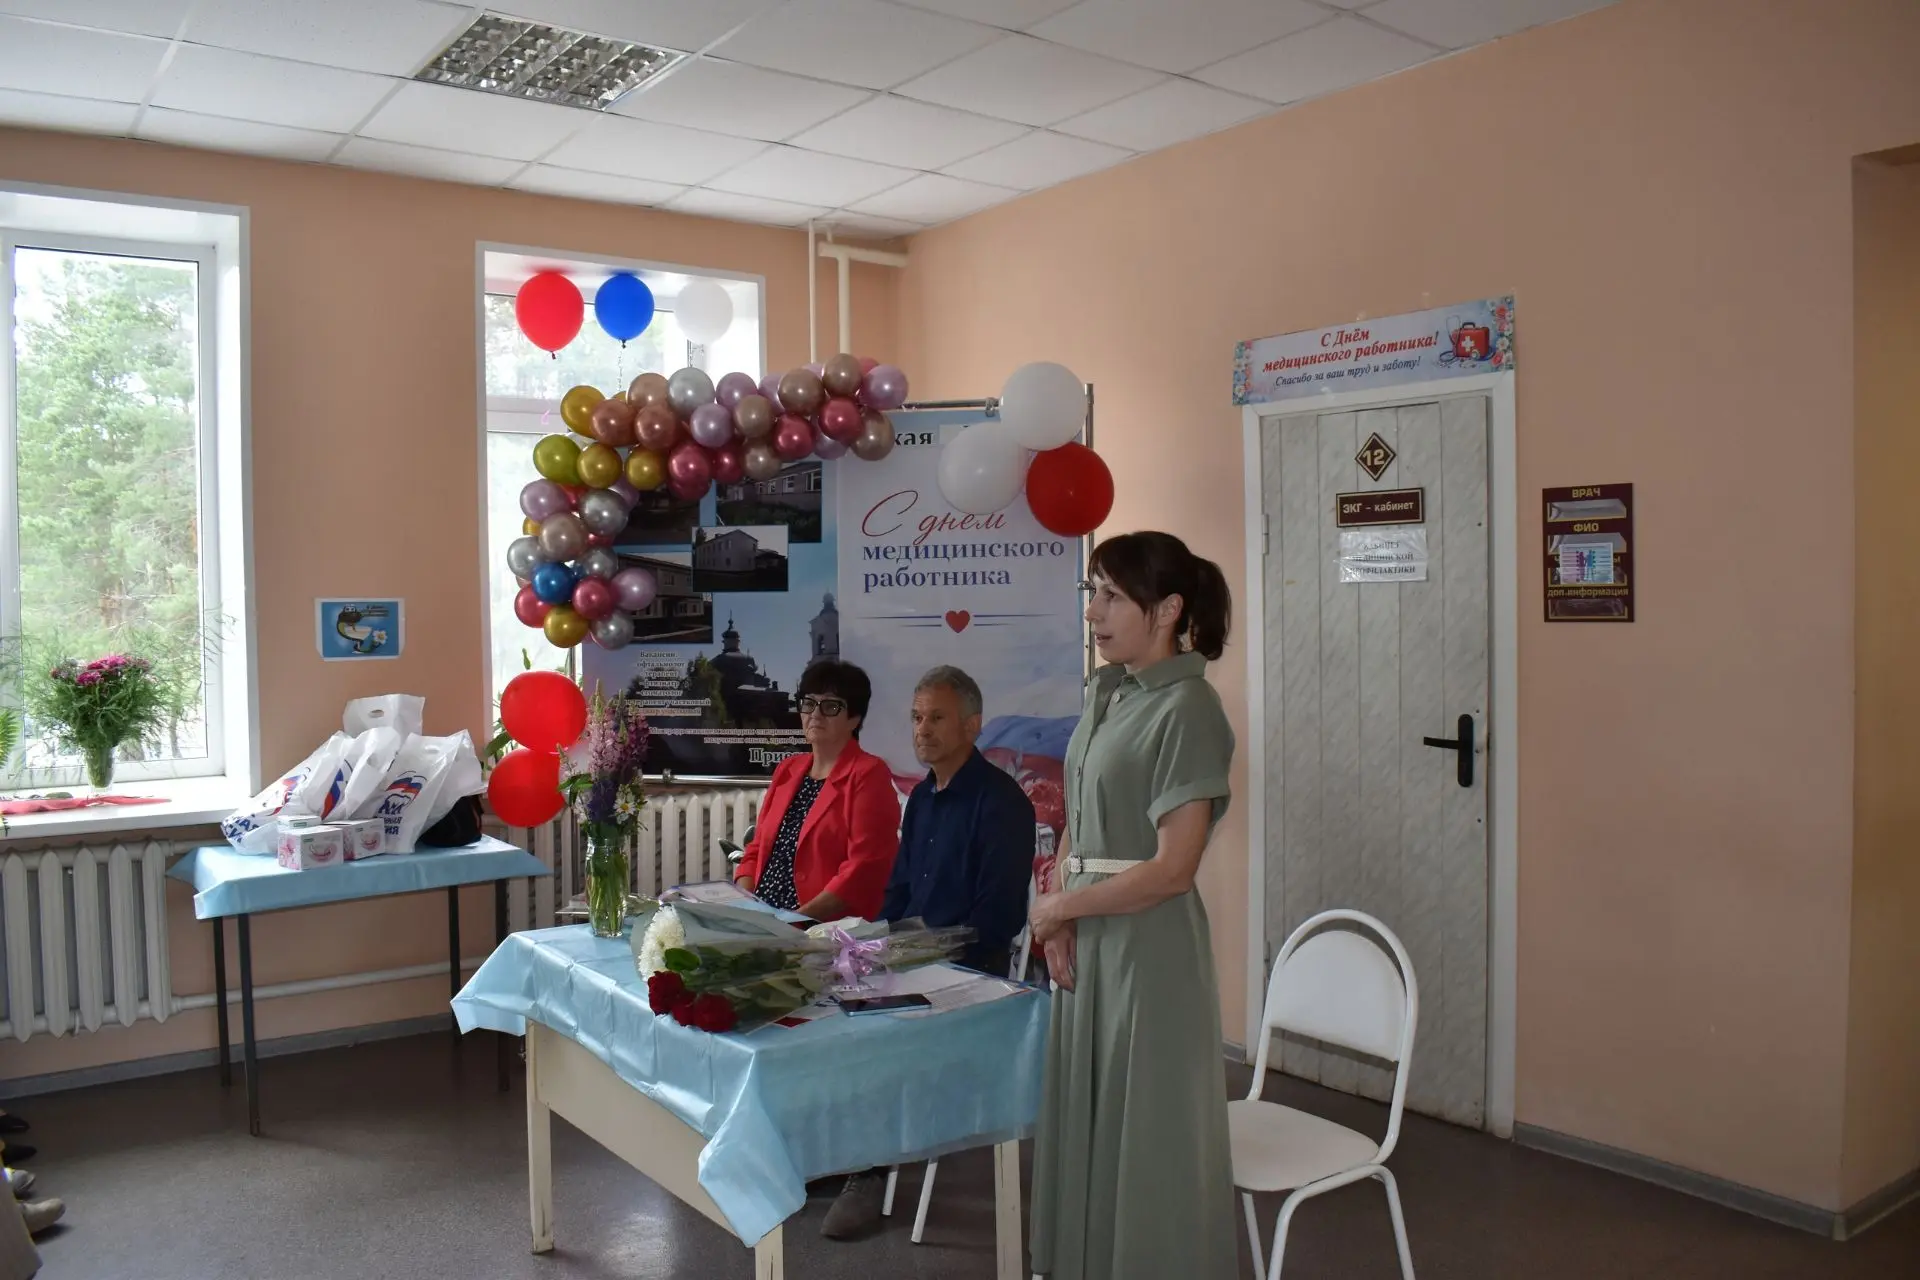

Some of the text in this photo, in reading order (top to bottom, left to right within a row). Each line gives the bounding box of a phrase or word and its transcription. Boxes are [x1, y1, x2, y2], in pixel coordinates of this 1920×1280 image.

[1321, 329, 1370, 349] С Днём
[1263, 331, 1439, 372] медицинского работника!
[1275, 372, 1312, 386] Спасибо
[1314, 373, 1324, 381] за
[1326, 370, 1345, 379] ваш
[1347, 366, 1370, 378] труд
[1382, 356, 1421, 371] заботу!
[1362, 450, 1385, 466] 12
[1572, 488, 1601, 498] ВРАЧ
[861, 490, 1008, 546] С днем
[1342, 503, 1362, 514] ЭКГ
[1374, 501, 1415, 512] кабинет
[1573, 523, 1600, 532] ФИО
[862, 541, 1065, 564] медицинского
[863, 567, 1011, 594] работника
